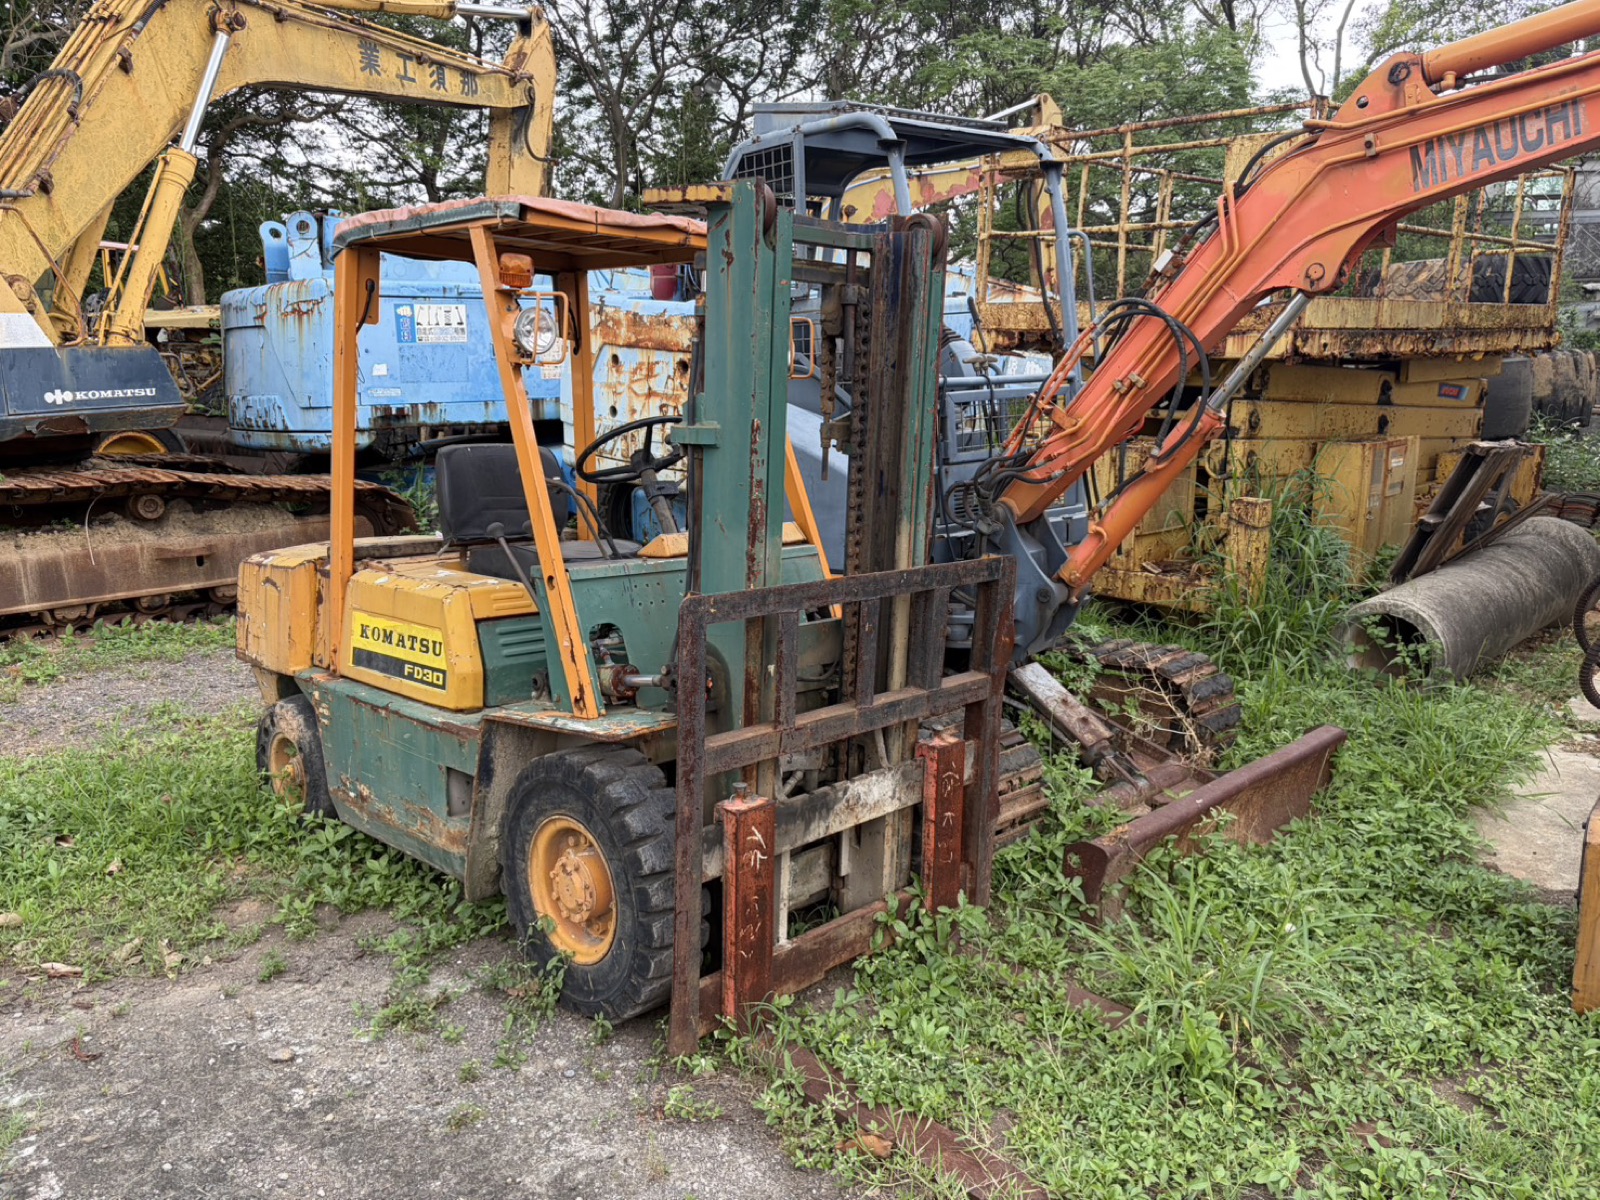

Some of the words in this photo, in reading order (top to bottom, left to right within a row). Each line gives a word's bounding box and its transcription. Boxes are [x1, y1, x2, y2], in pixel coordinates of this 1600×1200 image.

[1409, 95, 1583, 193] MIYAUCHI
[75, 388, 157, 401] KOMATSU
[360, 623, 443, 657] KOMATSU
[404, 663, 444, 686] FD30
